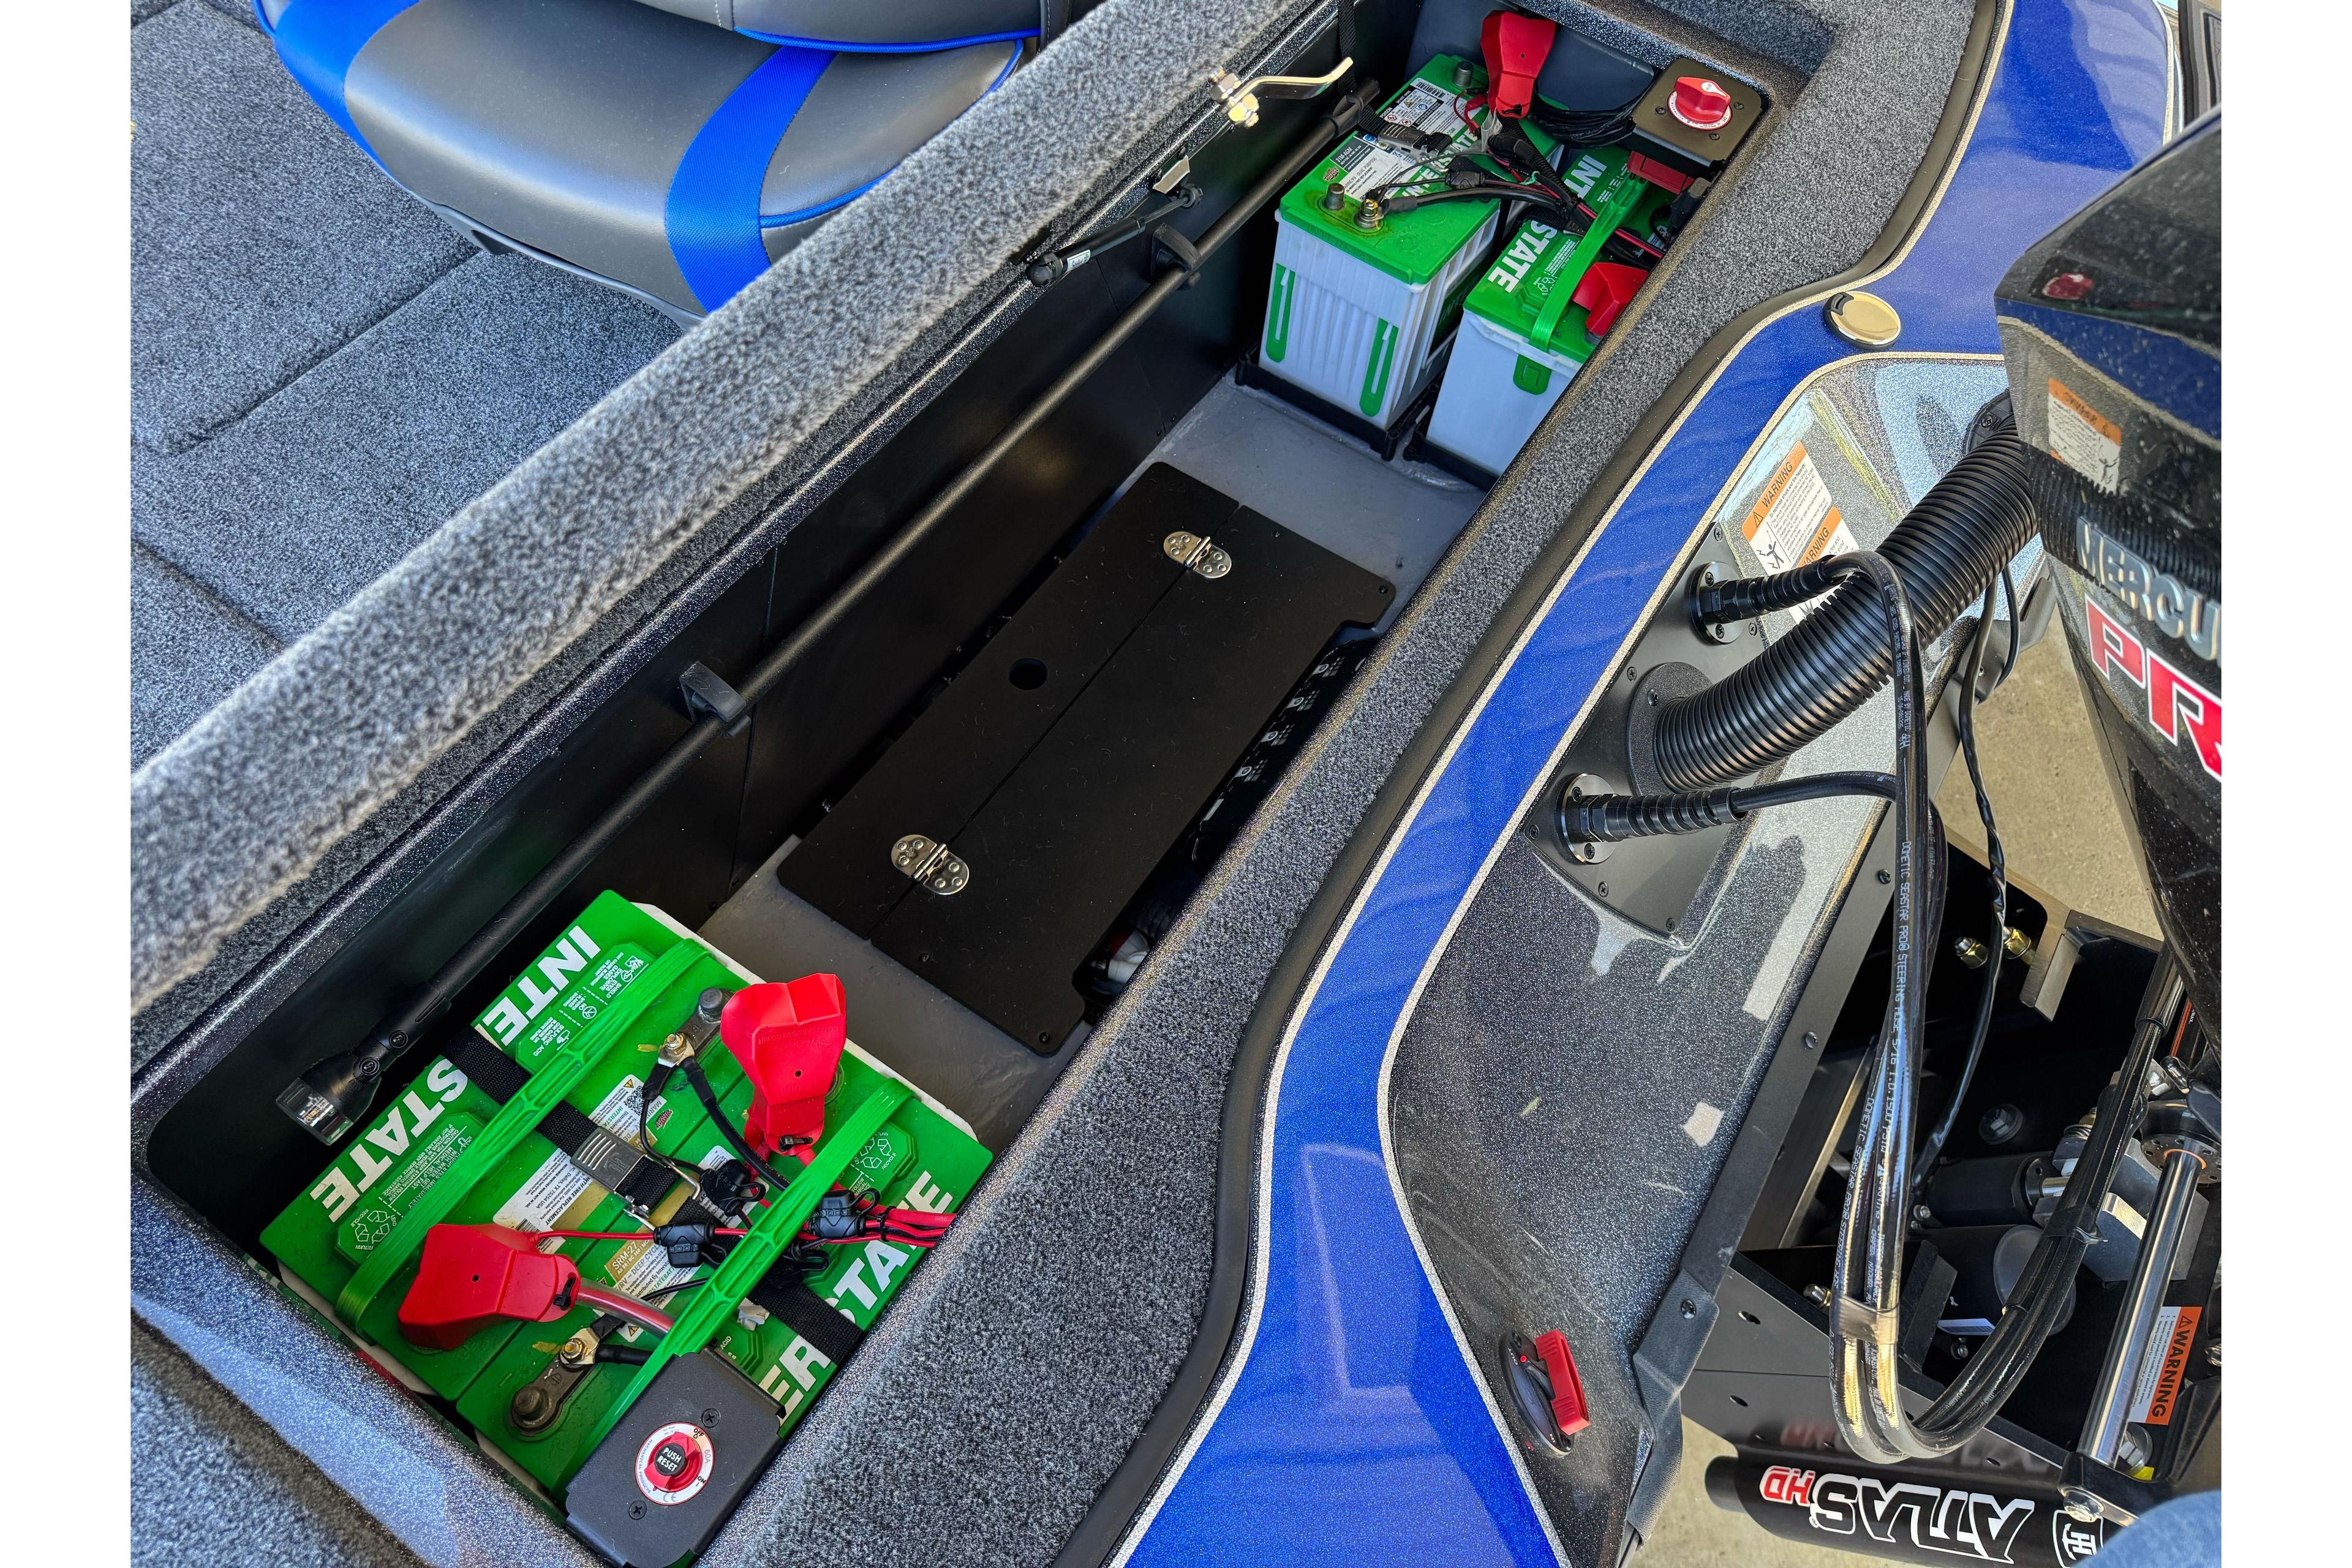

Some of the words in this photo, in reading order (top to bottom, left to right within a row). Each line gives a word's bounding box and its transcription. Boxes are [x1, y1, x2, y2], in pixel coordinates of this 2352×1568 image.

[1760, 460, 1794, 508] WARNING
[1801, 526, 1831, 568] ARNING
[1899, 841, 1911, 878] DOMETIC
[1898, 882, 1910, 921] SEASTAR
[599, 967, 622, 991] EXPLOSIVE
[603, 965, 618, 980] GASES
[1894, 954, 1908, 1001] STEERING
[605, 979, 617, 992] EYES
[605, 982, 622, 998] SHIELD
[578, 1002, 586, 1011] NO
[1891, 1007, 1902, 1033] HOSE
[543, 1024, 564, 1046] SULFURIC
[532, 1044, 545, 1057] ACID
[1890, 1039, 1899, 1065] 5/16
[1857, 1097, 1874, 1140] DOMETIC
[431, 1126, 454, 1151] INSTRUCTIONS
[427, 1151, 437, 1161] SAFE
[433, 1145, 453, 1166] MEDICAL
[435, 1144, 444, 1152] FOR
[445, 1149, 457, 1162] WITH
[413, 1153, 429, 1169] VEHICLE
[418, 1159, 428, 1170] JUMP
[881, 1152, 897, 1170] RECYCLE
[1847, 1145, 1863, 1188] SEASTAR
[402, 1169, 419, 1187] STARTING
[421, 1164, 435, 1178] HELP
[557, 1171, 571, 1186] Dallas,
[410, 1177, 423, 1189] FAST
[419, 1177, 430, 1188] GET
[570, 1186, 581, 1197] FREE
[388, 1186, 403, 1201] FOLLOW
[407, 1178, 436, 1208] IMMEDIATELY
[543, 1189, 555, 1202] 75254
[535, 1200, 545, 1209] USA
[544, 1196, 572, 1225] REPLACEMENT
[350, 1207, 369, 1227] RECYCLE
[1833, 1221, 1848, 1266] STEERING
[611, 1242, 638, 1270] SRM-27
[630, 1258, 646, 1275] DEEP
[643, 1242, 662, 1260] CYCL
[718, 1335, 732, 1349] ACID
[2151, 1329, 2190, 1418] WARNING
[693, 1428, 704, 1437] OFF
[657, 1455, 677, 1471] RESET
[663, 1447, 682, 1463] PUSH
[1759, 1465, 1815, 1507] HD
[1811, 1474, 2035, 1564] ATLAS
